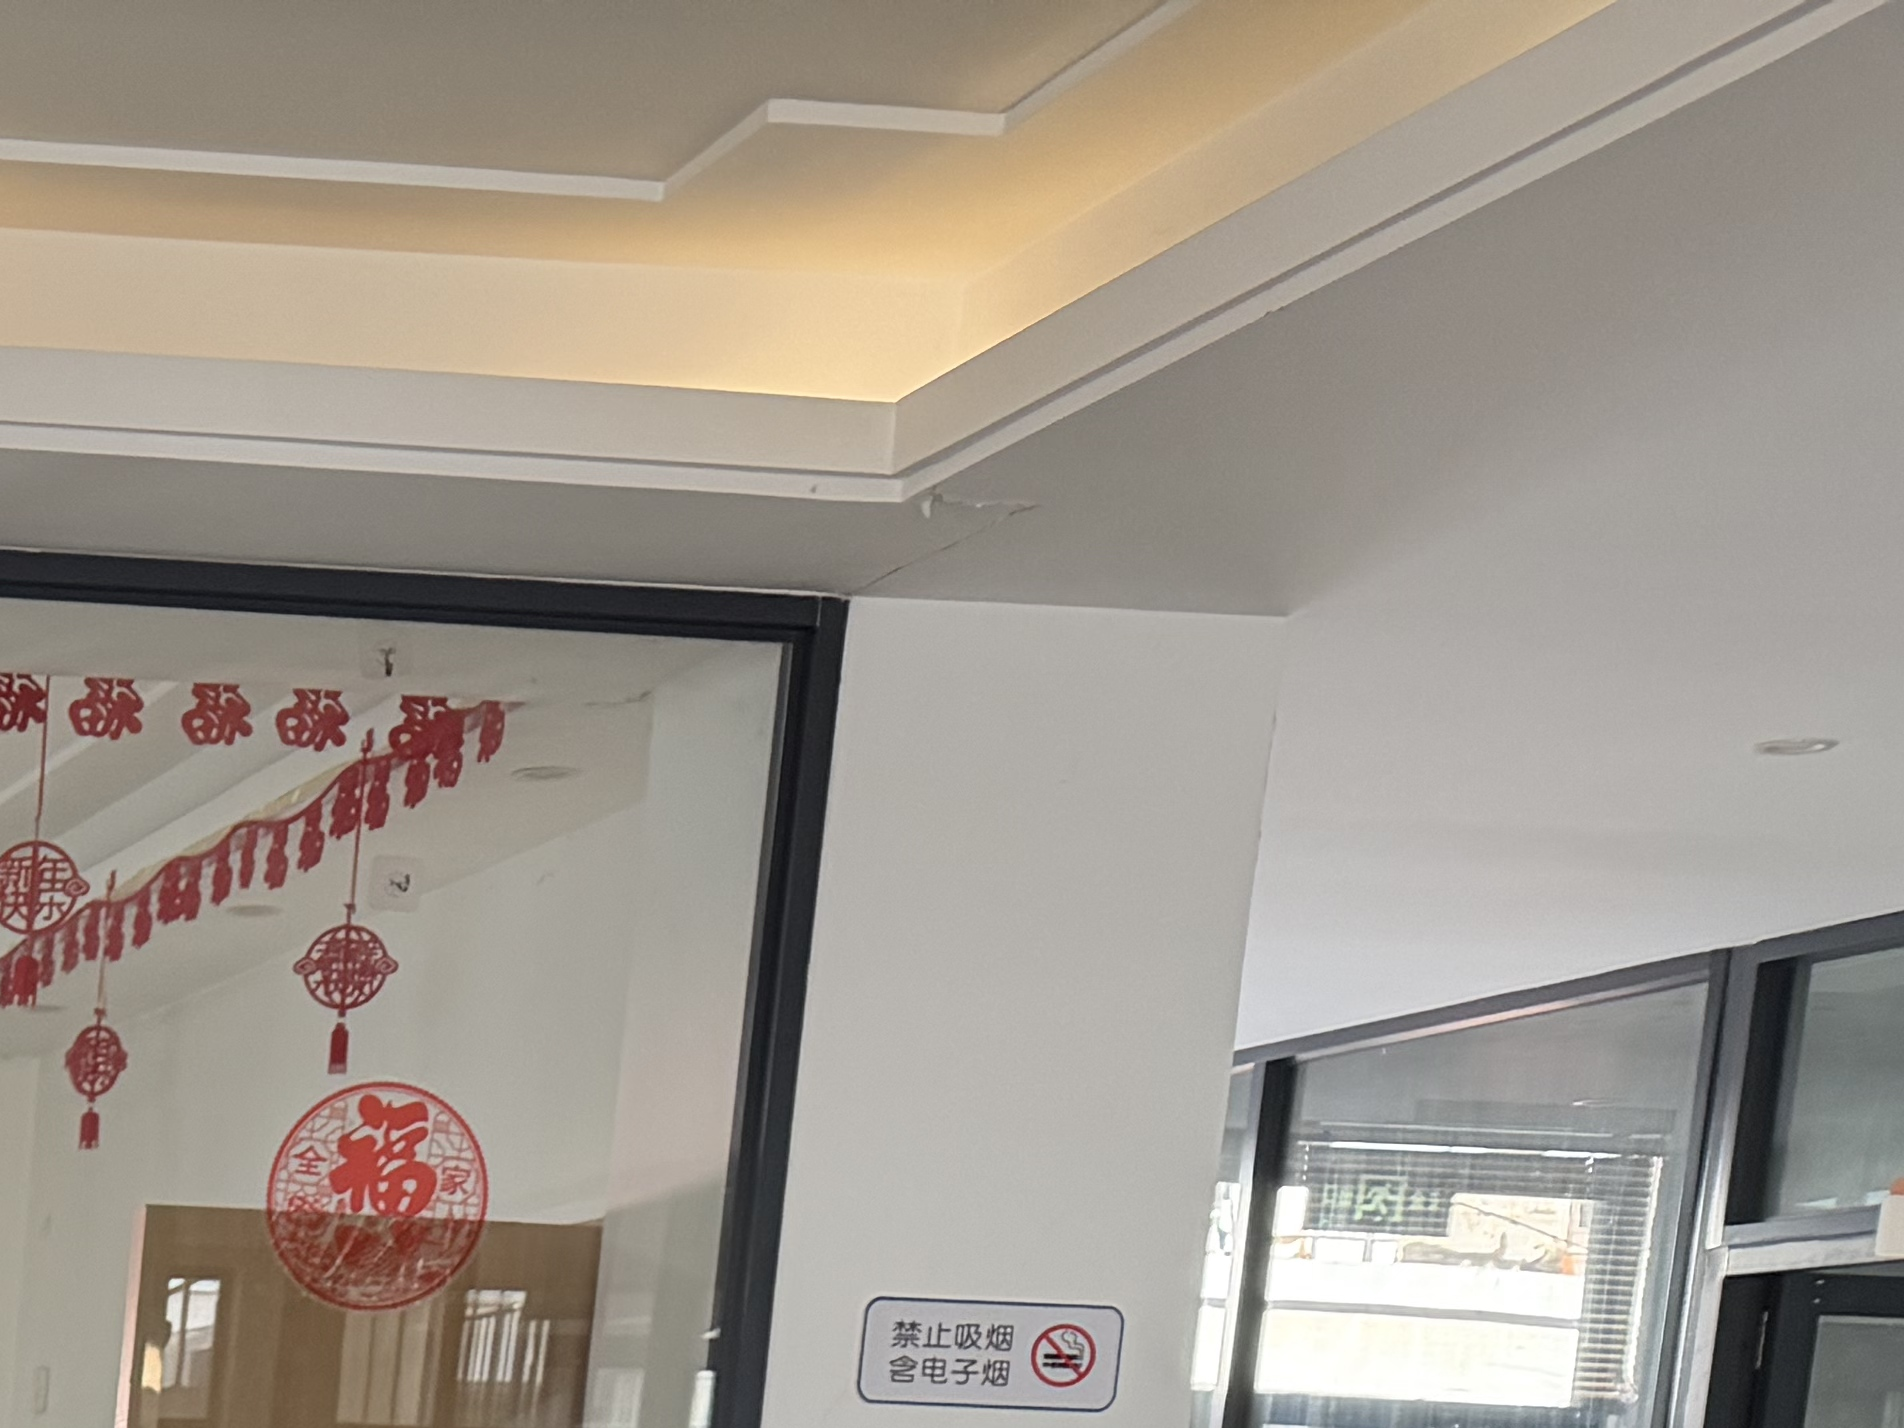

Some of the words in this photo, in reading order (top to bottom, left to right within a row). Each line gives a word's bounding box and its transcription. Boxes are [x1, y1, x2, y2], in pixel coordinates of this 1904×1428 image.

[890, 1318, 1015, 1351] 禁止吸烟
[888, 1354, 1011, 1387] 含电子烟
